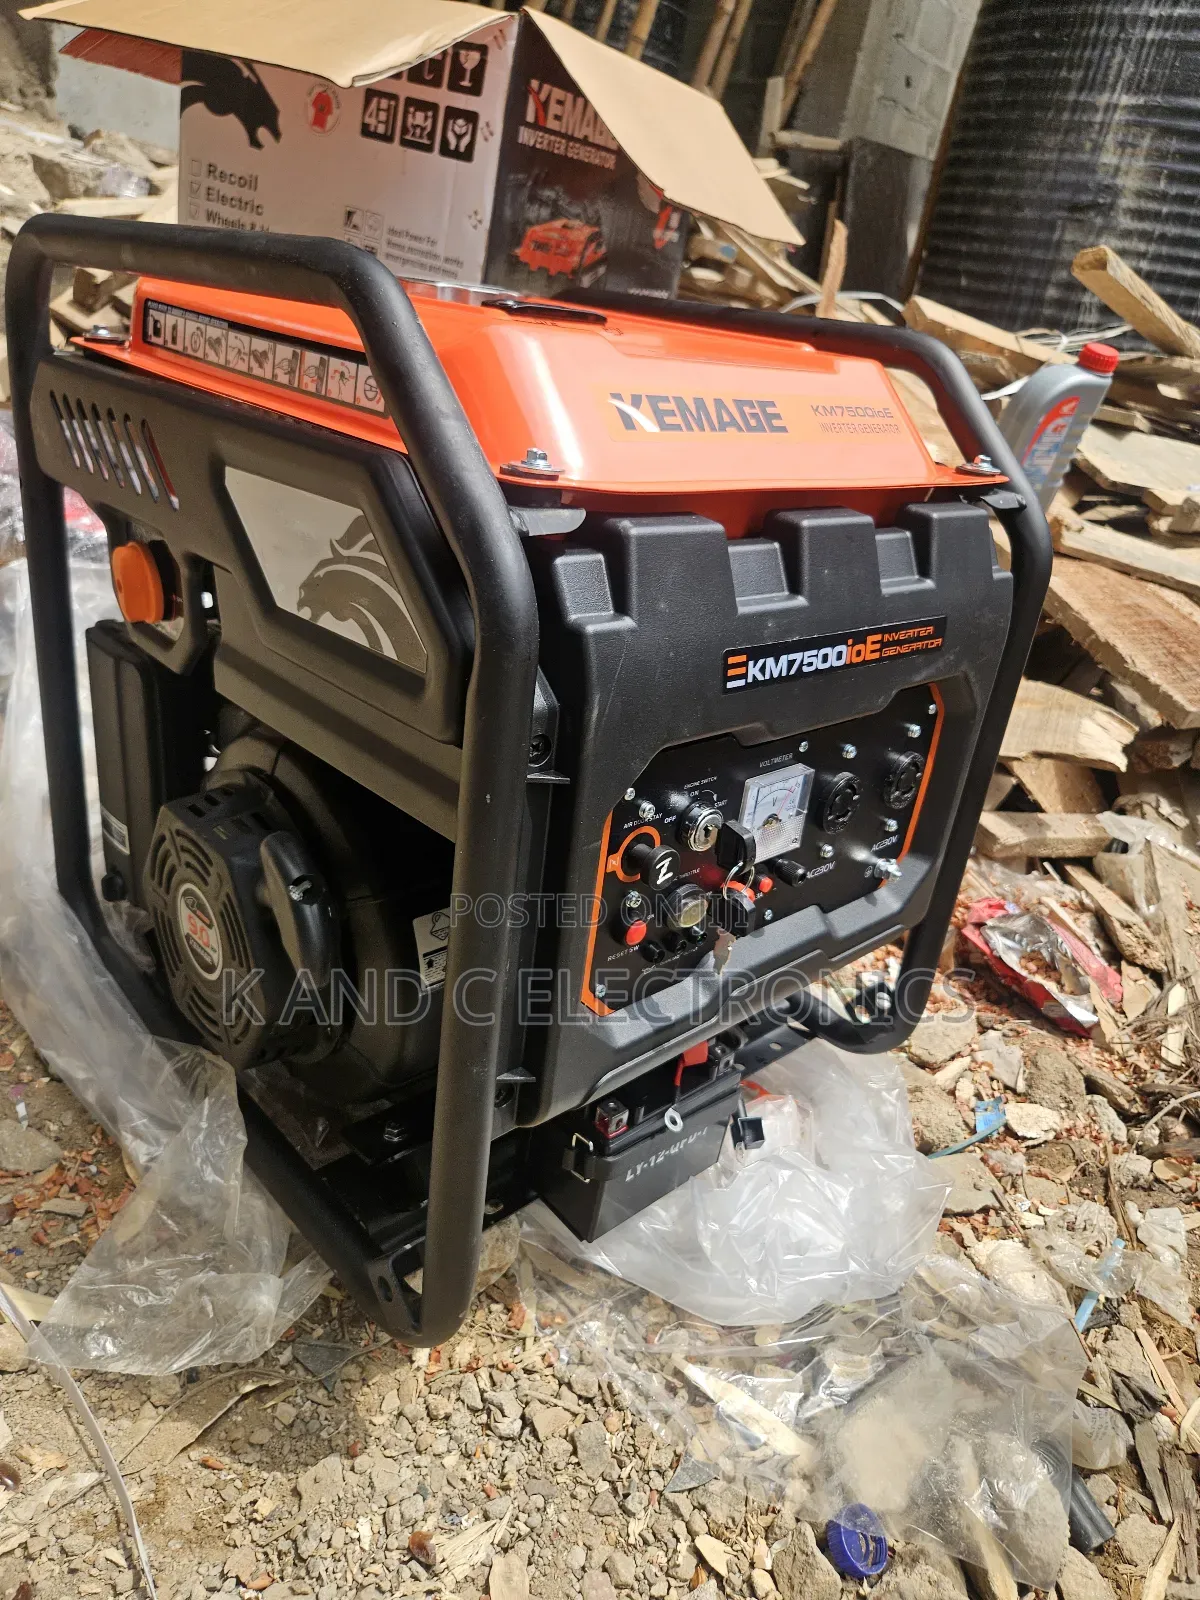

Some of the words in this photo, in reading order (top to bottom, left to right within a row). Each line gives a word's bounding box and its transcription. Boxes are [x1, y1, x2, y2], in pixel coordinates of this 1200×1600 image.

[517, 125, 567, 157] INVERTER
[207, 162, 259, 192] Recoil
[205, 186, 265, 216] Electric
[606, 392, 789, 433] KEMAGE
[810, 404, 894, 419] KM7500ioE
[819, 422, 858, 434] INVERTER
[858, 423, 901, 434] GENERATOR
[883, 625, 935, 643] INVERTER
[881, 637, 943, 657] GENERATOR
[759, 752, 794, 768] VOLTMETER
[683, 780, 700, 790] ENGINE
[714, 799, 728, 808] START
[623, 820, 634, 829] AIR
[870, 834, 899, 853] AC230V
[806, 860, 836, 879] AC230V
[607, 949, 628, 962] RESET
[628, 944, 640, 953] SW
